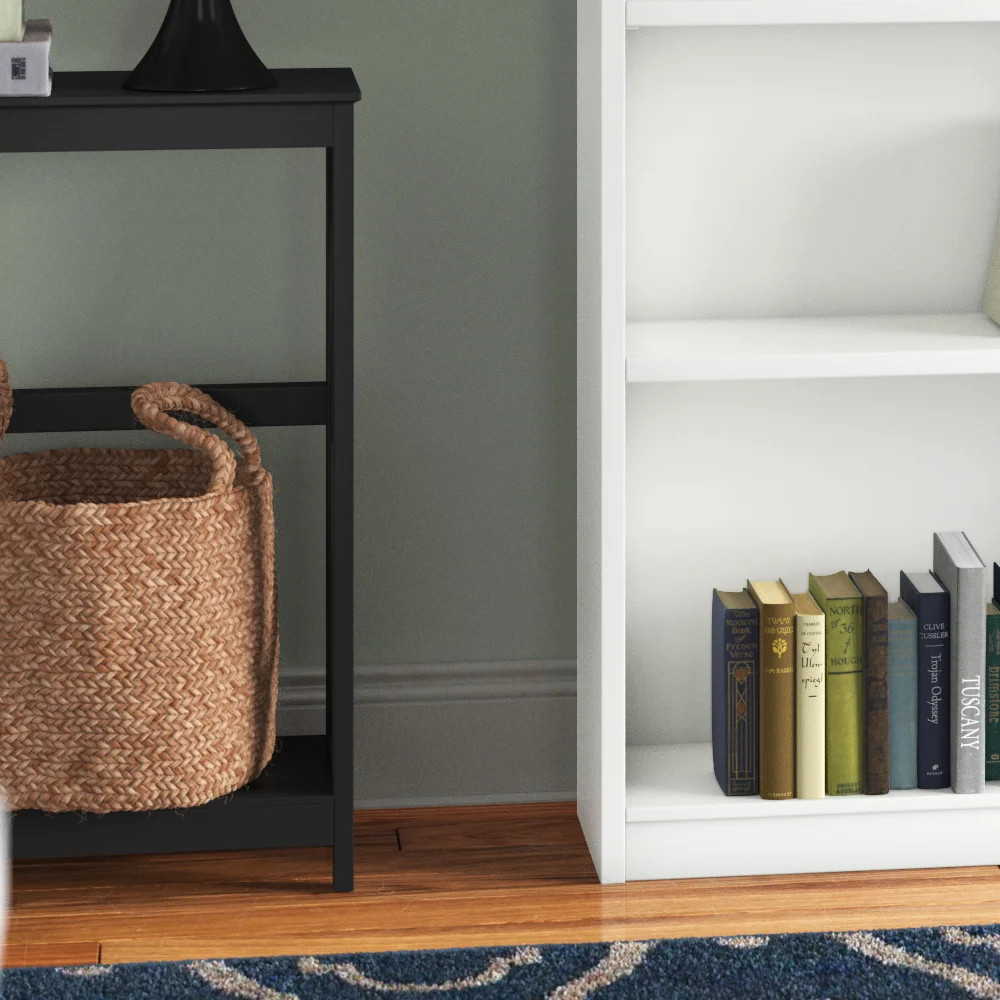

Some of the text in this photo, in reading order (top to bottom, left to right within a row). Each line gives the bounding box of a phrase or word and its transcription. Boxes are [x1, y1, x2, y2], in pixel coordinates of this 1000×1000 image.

[830, 605, 863, 616] NORTH
[840, 621, 855, 635] 36
[927, 652, 943, 725] Trojan Odyssey
[960, 675, 981, 751] TUSCANY
